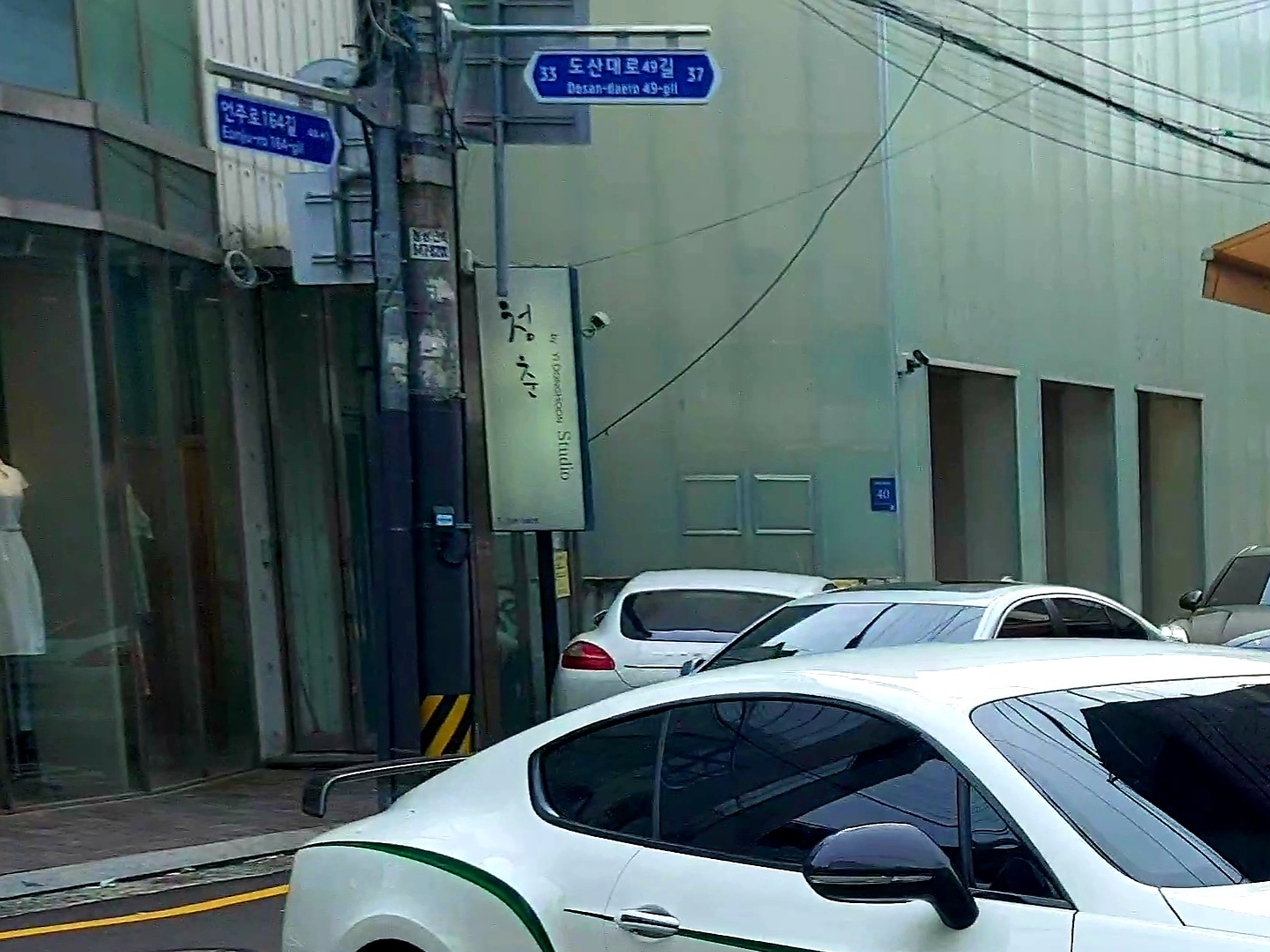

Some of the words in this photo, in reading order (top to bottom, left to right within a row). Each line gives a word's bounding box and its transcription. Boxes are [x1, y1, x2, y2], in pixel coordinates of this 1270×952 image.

[539, 65, 558, 82] 33
[568, 56, 675, 79] 도산대로49길
[687, 66, 704, 82] 37
[566, 81, 640, 95] Dosan-daero
[642, 81, 679, 97] 49-gil
[557, 430, 574, 481] Studio
